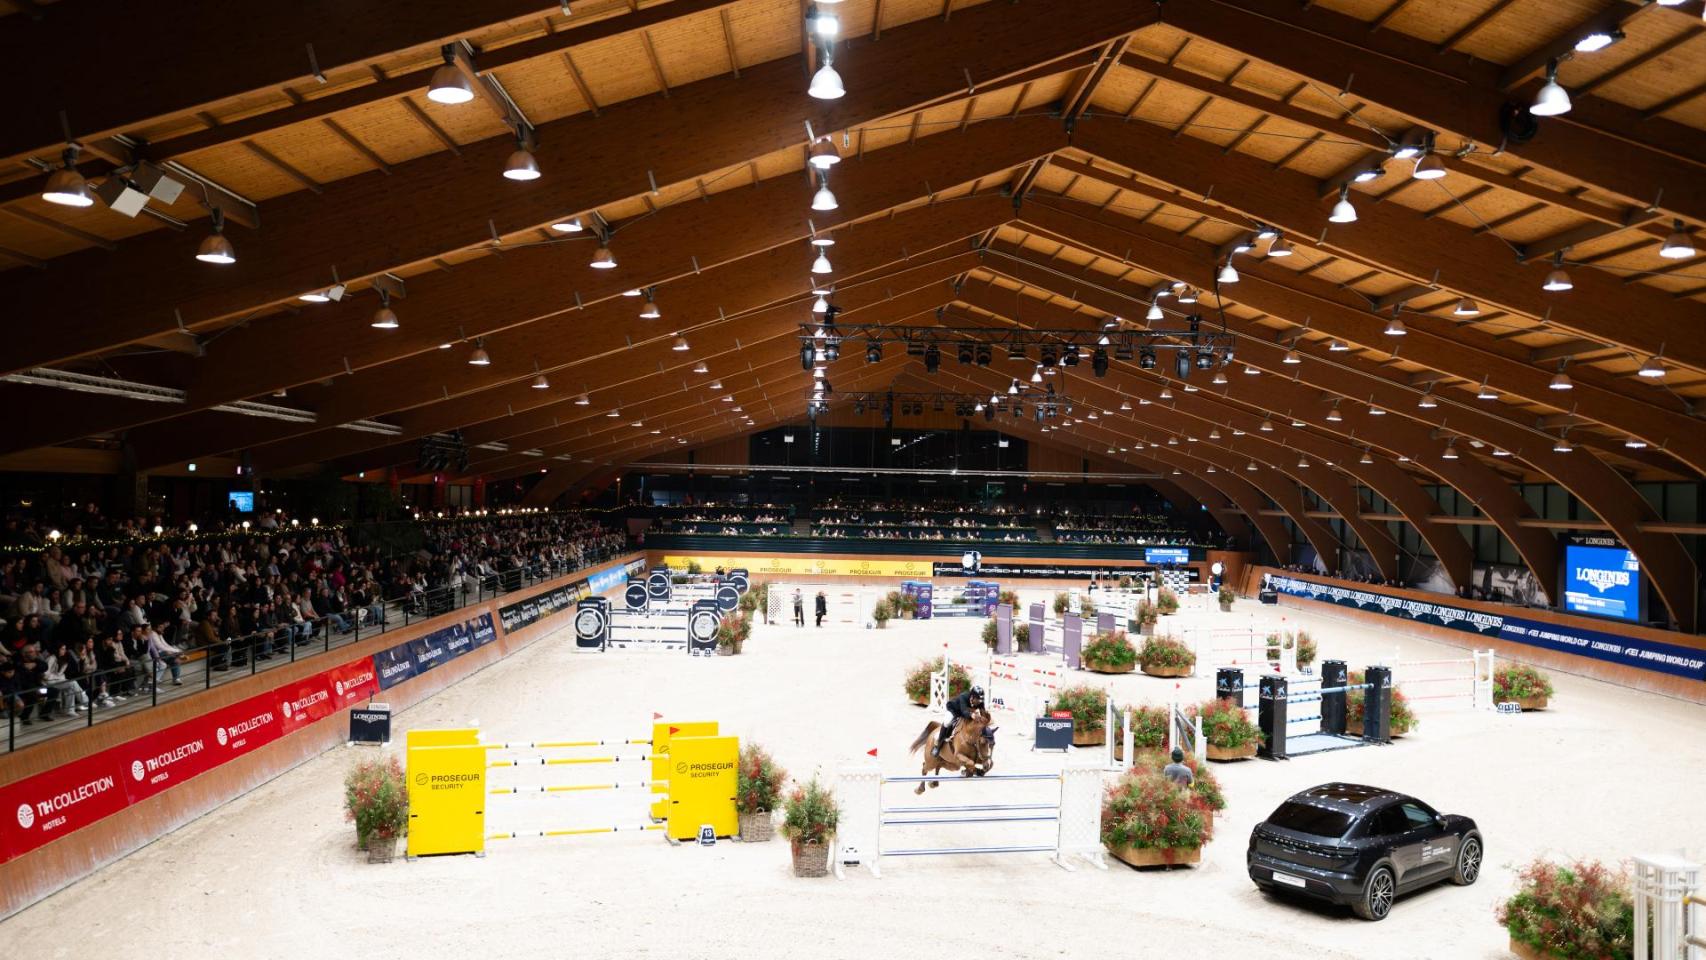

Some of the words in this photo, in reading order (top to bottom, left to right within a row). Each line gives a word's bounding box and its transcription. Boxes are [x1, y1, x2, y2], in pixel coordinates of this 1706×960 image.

[1585, 537, 1615, 546] LONGINES
[1576, 568, 1630, 586] LONGINES
[1375, 594, 1401, 609] LONGINES
[1402, 599, 1432, 613] LONGINES
[1432, 605, 1466, 620] LONGINES
[1465, 611, 1503, 627] LONGINES
[1539, 631, 1560, 642] JUMPING
[1559, 634, 1578, 645] WORLD
[1591, 640, 1621, 654] LONGINES
[1639, 650, 1667, 662] JUMPING
[1665, 655, 1689, 667] WORLD
[1688, 659, 1704, 669] CUP
[299, 690, 329, 710] COLLECTION
[237, 711, 274, 734] COLLECTION
[157, 739, 205, 767] COLLECTION
[690, 762, 734, 771] PROSEGUR
[151, 772, 169, 784] HOTELS
[431, 773, 480, 782] PROSEGUR
[53, 776, 114, 810] COLLECTION
[42, 815, 67, 832] HOTELS
[704, 829, 713, 837] 13
